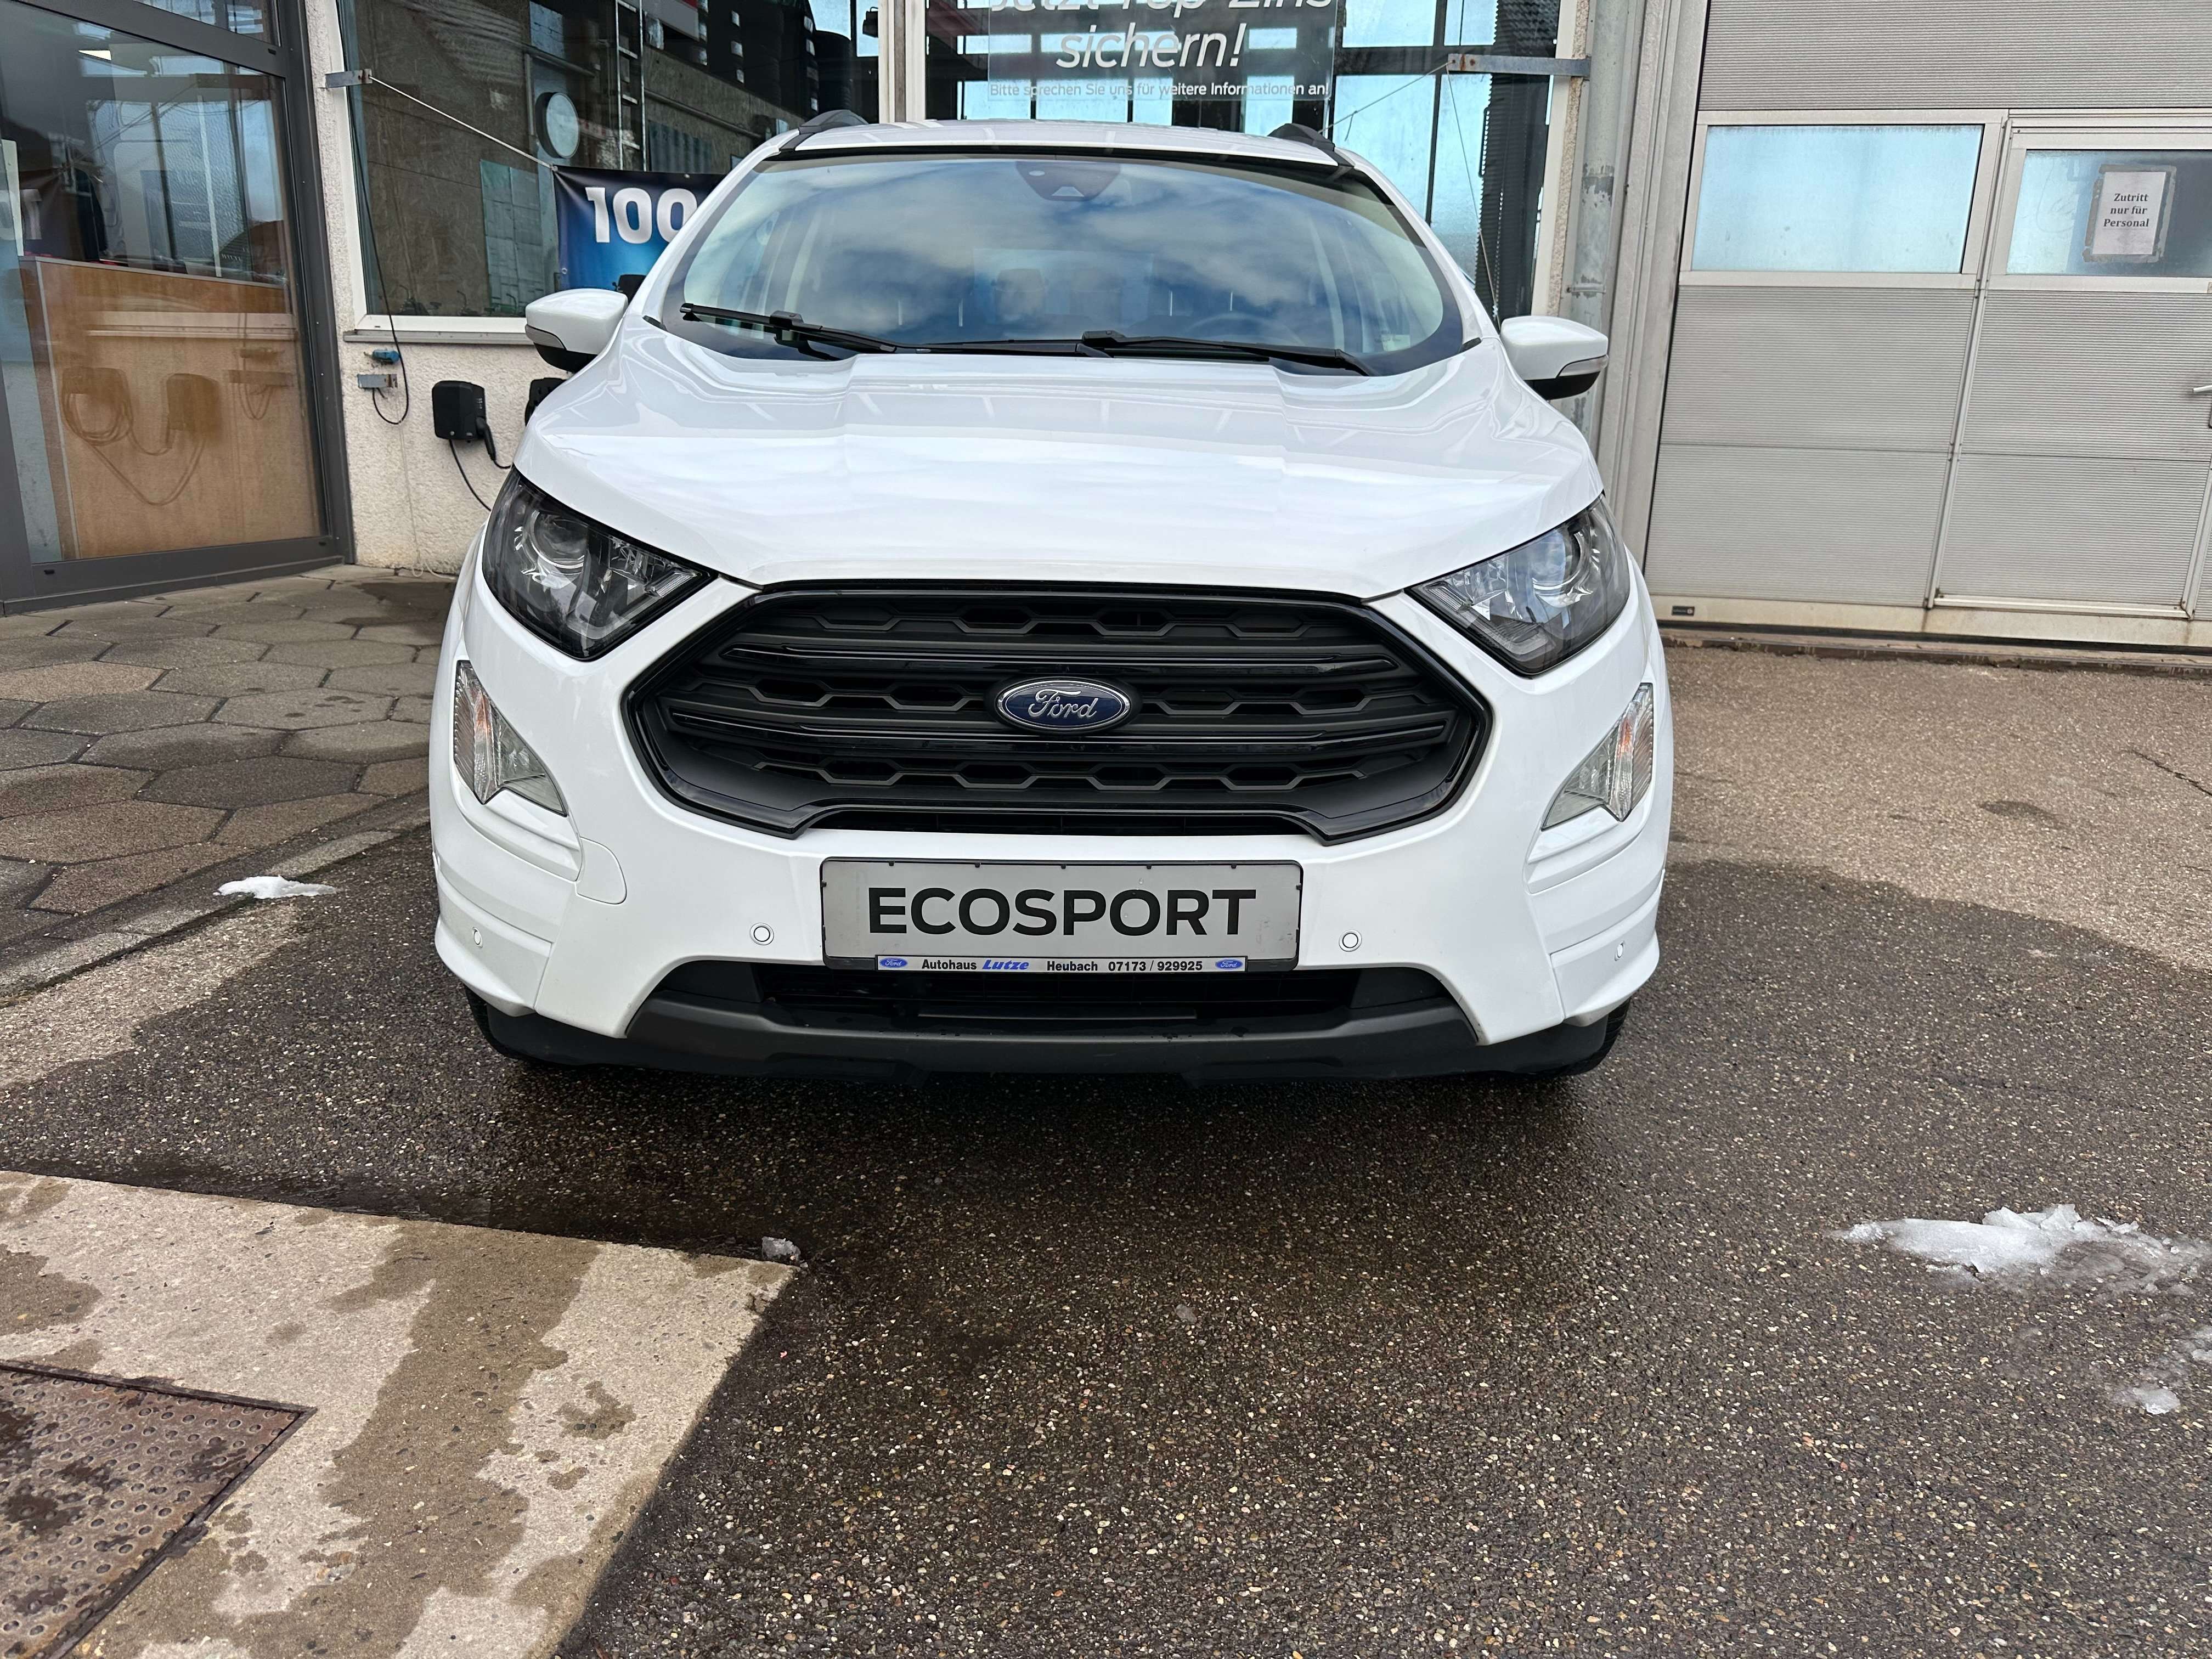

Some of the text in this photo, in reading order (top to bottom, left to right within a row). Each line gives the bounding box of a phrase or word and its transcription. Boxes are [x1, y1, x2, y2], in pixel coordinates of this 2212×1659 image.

[1056, 22, 1247, 68] sichern!
[990, 82, 1329, 99] Bitte sprechen Sie uns für weitere Informationen an!
[2114, 193, 2148, 201] Zutritt
[2131, 205, 2147, 215] für
[2103, 218, 2149, 227] Personal
[1028, 689, 1098, 718] Ford
[868, 887, 1256, 936] ECOSPORT
[921, 959, 977, 970] Autohaus
[982, 960, 1029, 970] Lutze
[1047, 961, 1098, 971] Heubach
[1108, 961, 1147, 971] 07173
[1157, 961, 1203, 971] 929925
